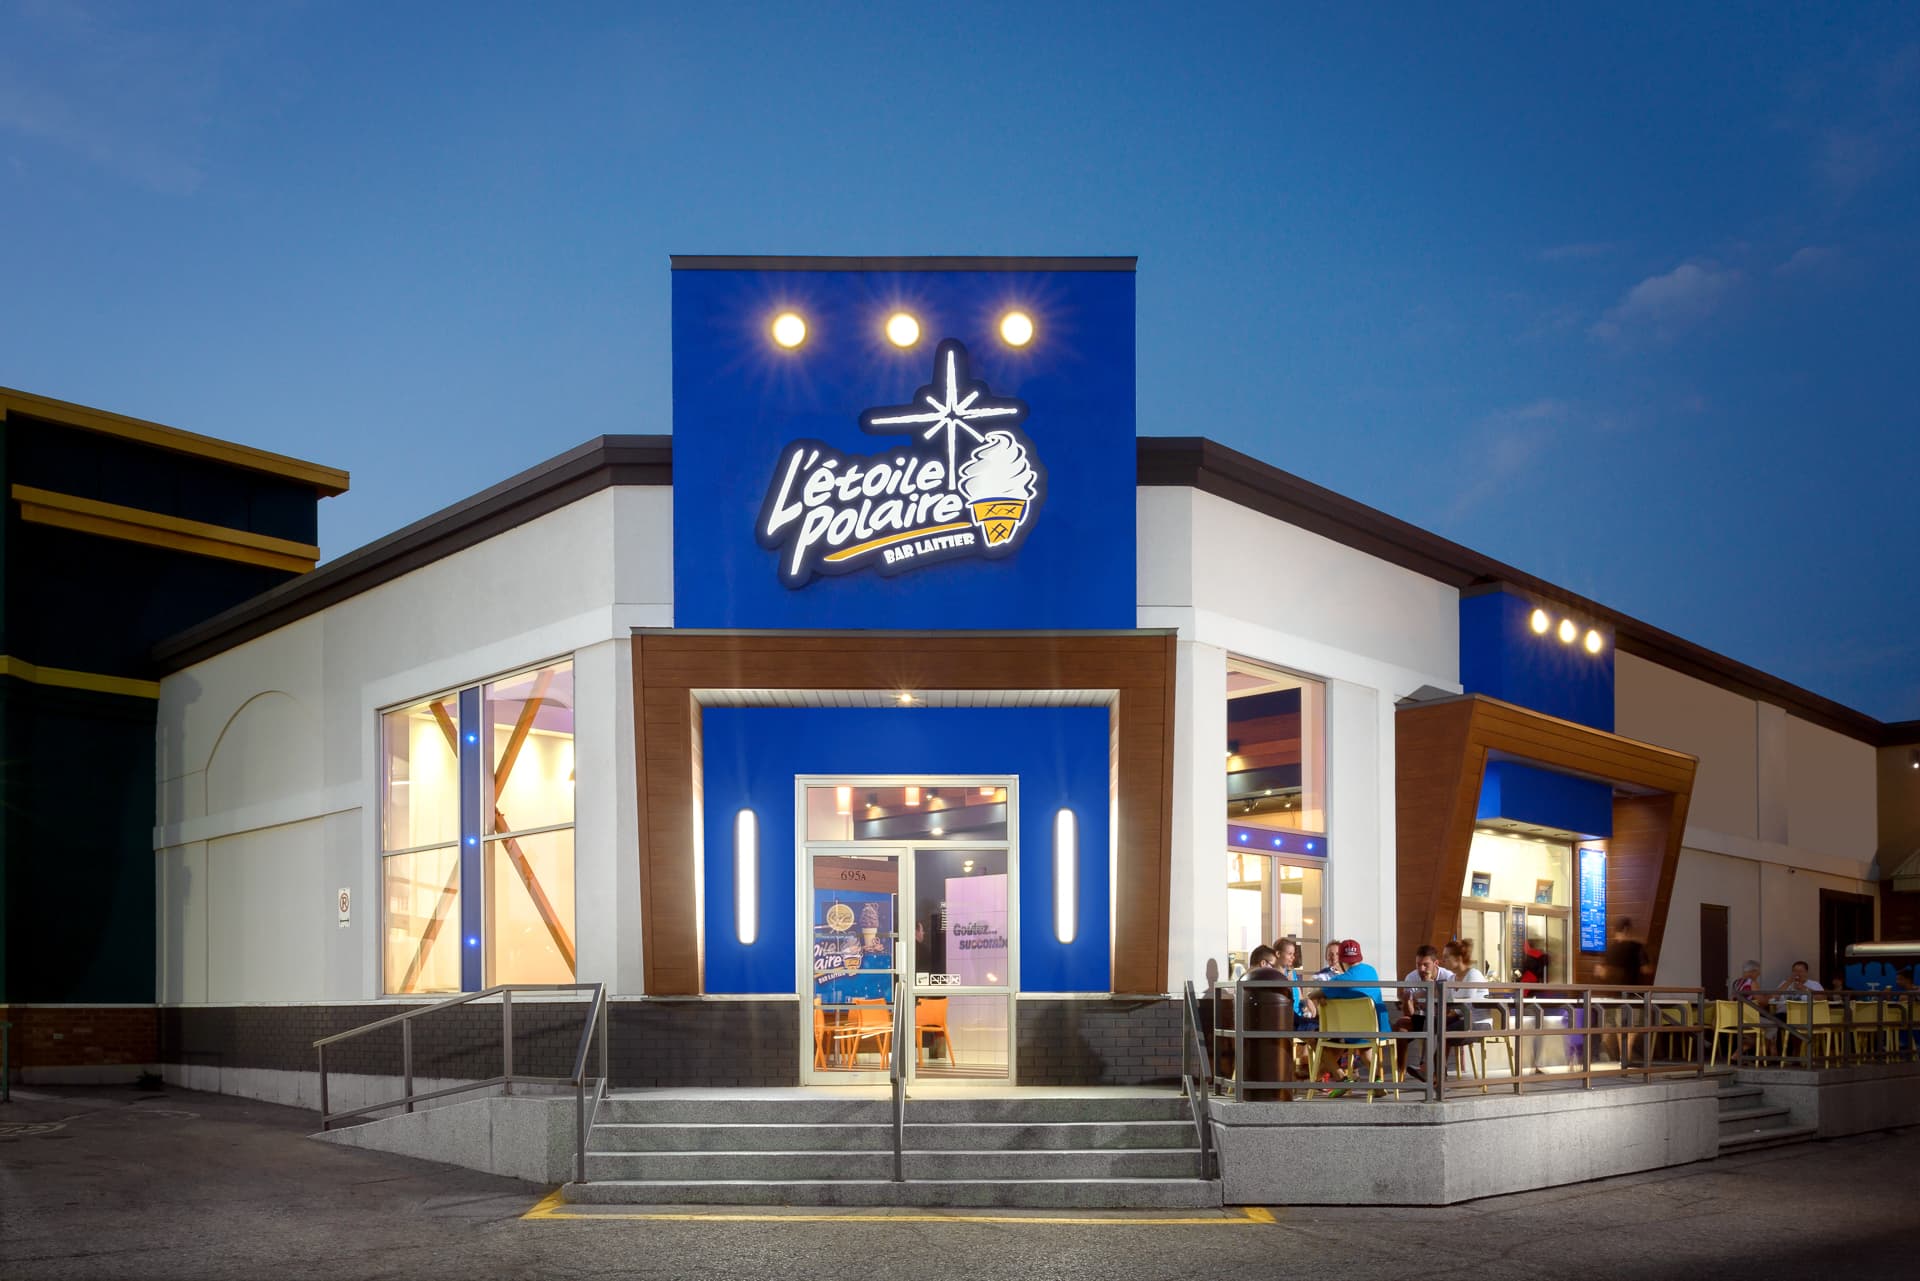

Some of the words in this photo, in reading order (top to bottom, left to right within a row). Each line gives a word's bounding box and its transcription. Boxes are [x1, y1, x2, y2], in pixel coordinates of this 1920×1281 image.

[883, 544, 914, 564] BAR
[914, 533, 975, 554] LAITIER
[840, 870, 866, 881] 695A
